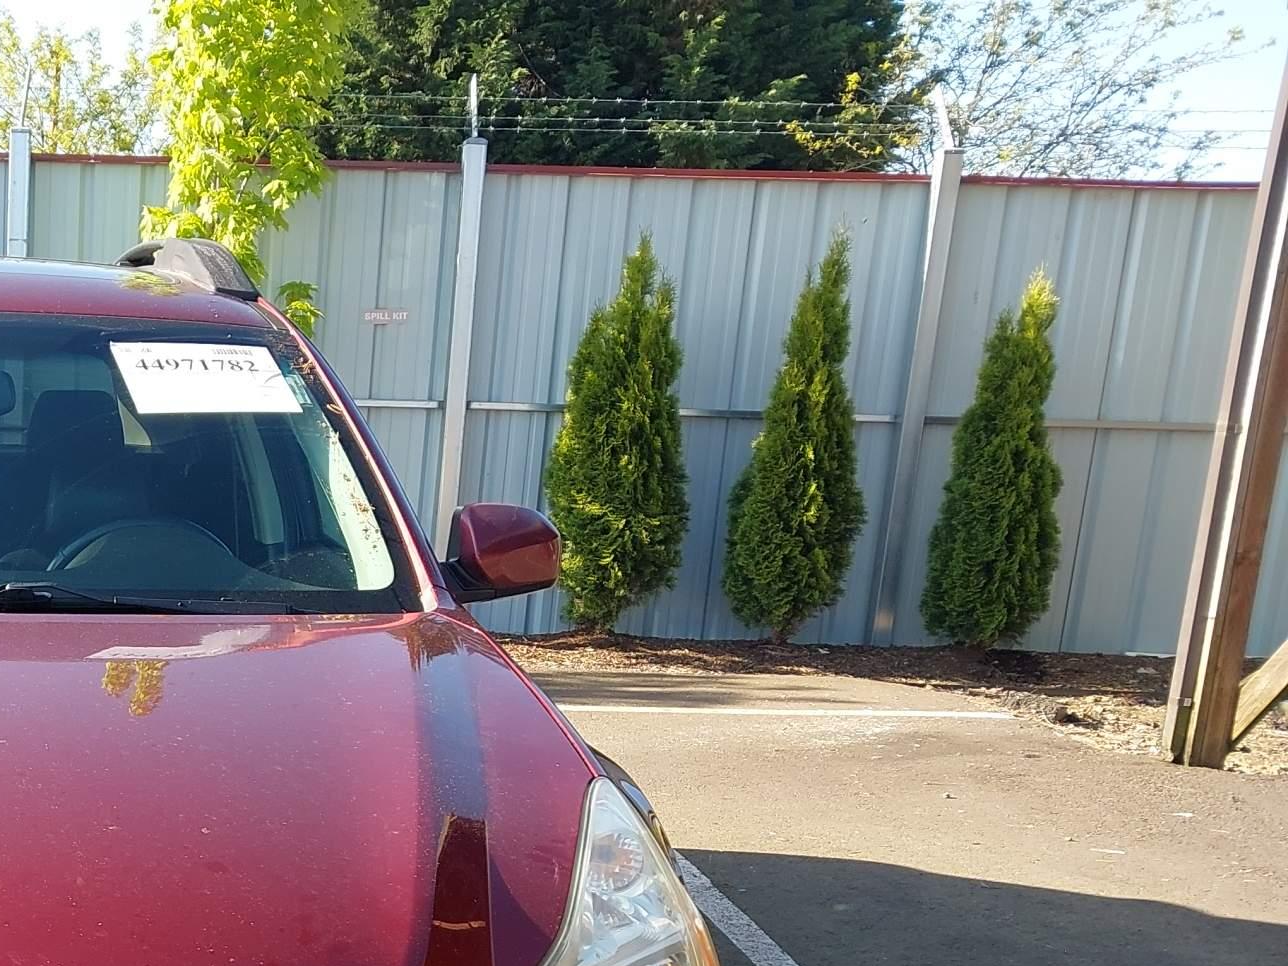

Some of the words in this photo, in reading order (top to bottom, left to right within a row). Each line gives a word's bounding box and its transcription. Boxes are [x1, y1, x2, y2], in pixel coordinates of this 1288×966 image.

[364, 311, 391, 320] SPILL
[392, 311, 409, 320] KIT
[135, 358, 260, 372] 44971782
